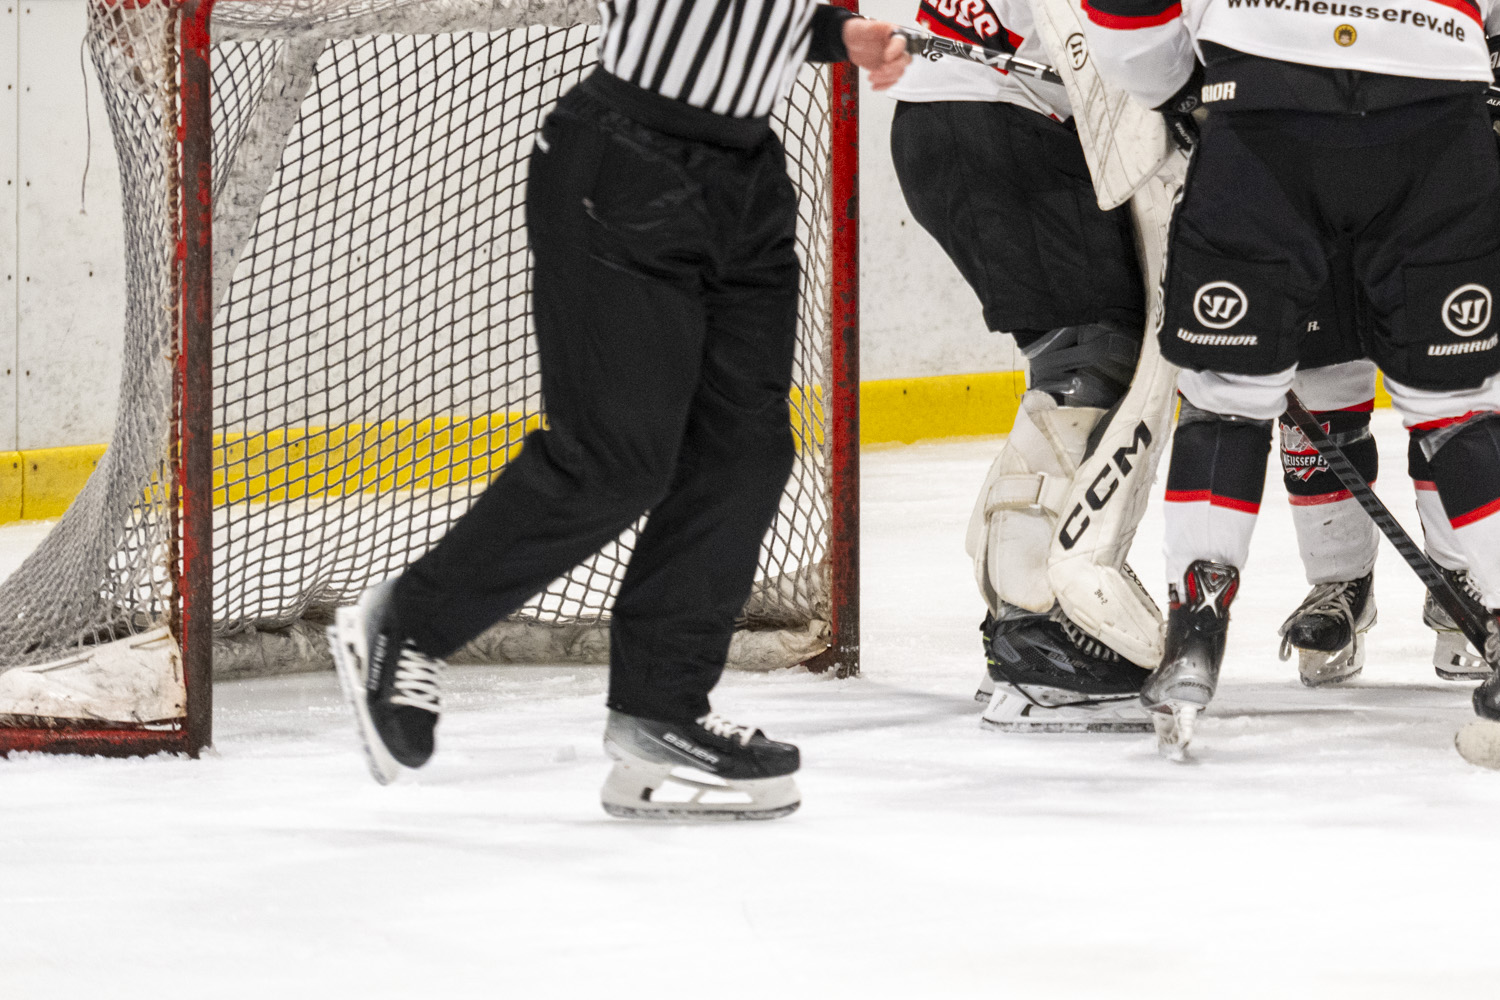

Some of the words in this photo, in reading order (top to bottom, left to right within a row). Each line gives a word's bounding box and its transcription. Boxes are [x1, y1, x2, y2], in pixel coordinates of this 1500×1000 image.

[1177, 327, 1257, 347] WARRIOR
[1058, 420, 1153, 551] CCM
[663, 732, 719, 764] BAUER
